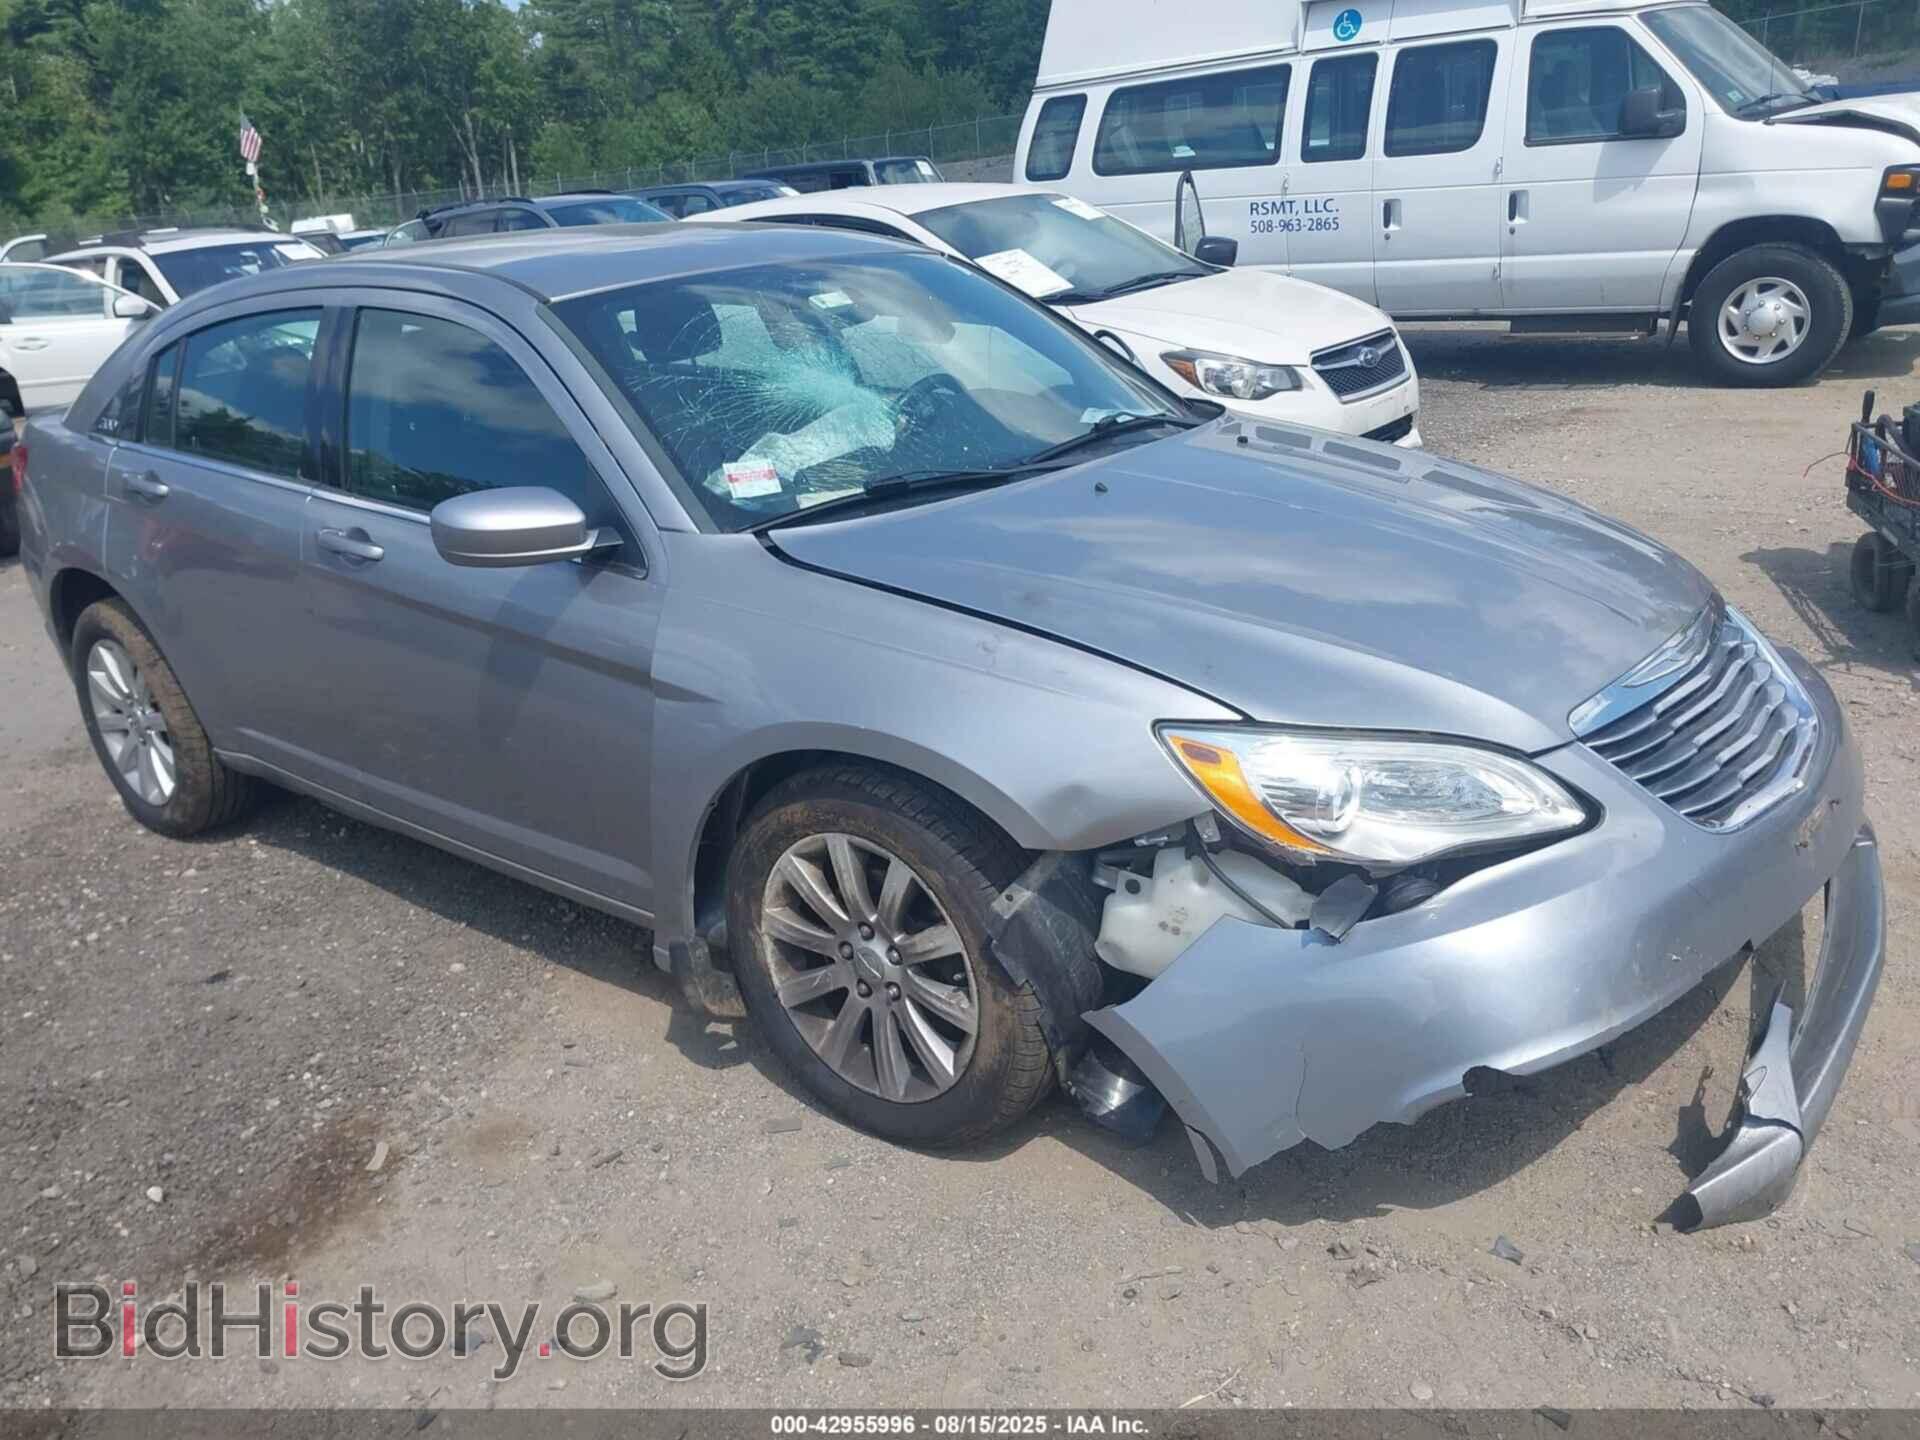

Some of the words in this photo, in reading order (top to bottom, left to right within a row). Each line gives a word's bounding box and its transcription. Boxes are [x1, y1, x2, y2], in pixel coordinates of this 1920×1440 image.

[1250, 200, 1299, 216] RSMT,
[1304, 198, 1339, 214] LLC.
[1250, 217, 1340, 234] 508-963-2865
